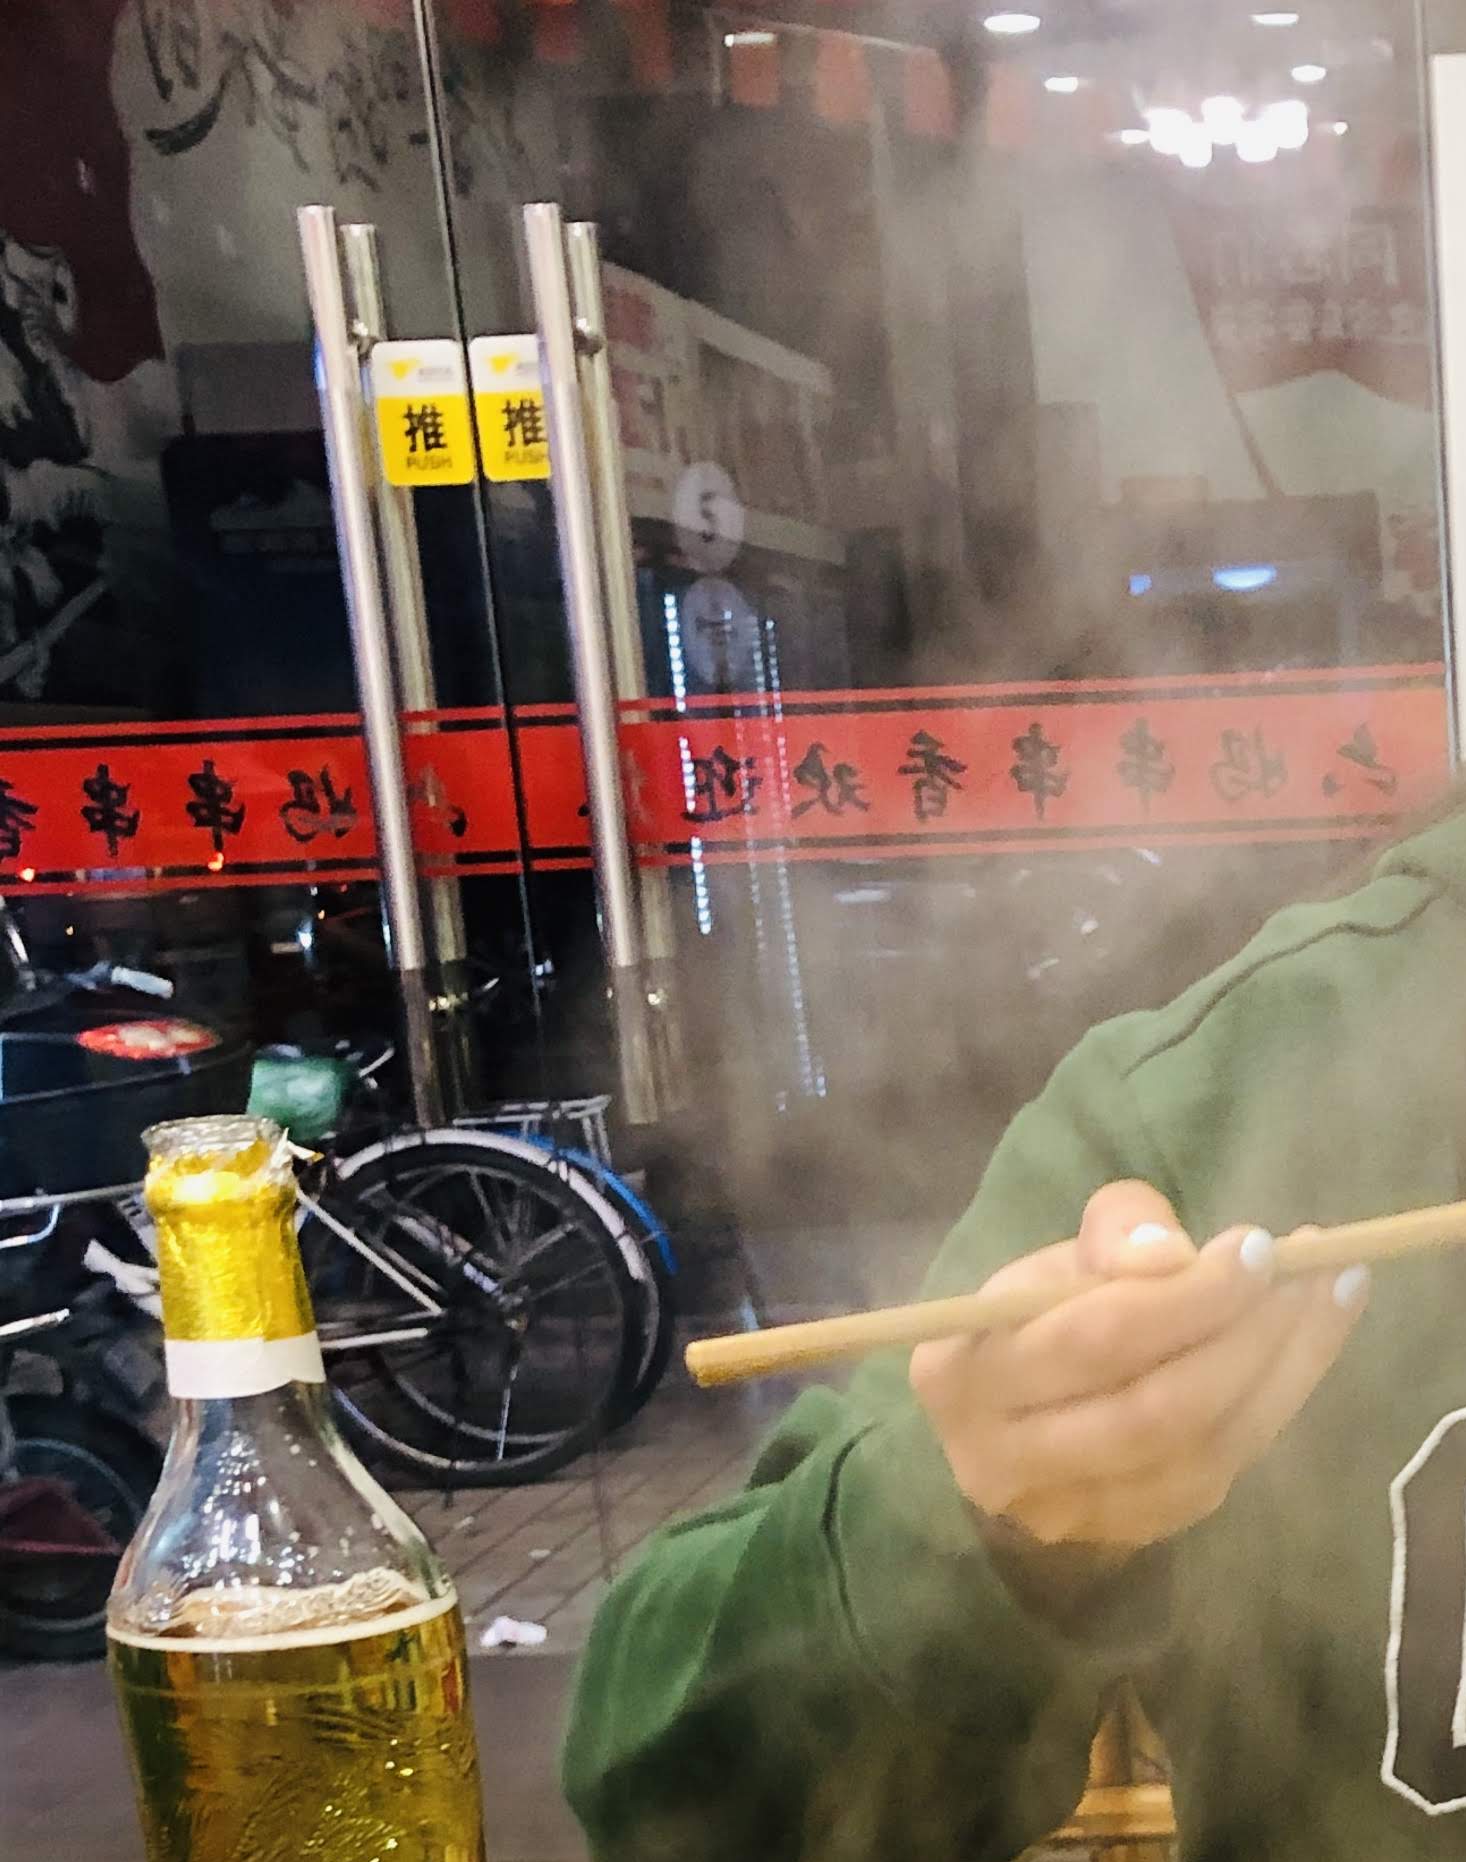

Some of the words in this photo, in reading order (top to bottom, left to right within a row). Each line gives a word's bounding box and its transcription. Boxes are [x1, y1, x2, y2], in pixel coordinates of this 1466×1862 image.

[403, 403, 447, 452] 推
[501, 397, 548, 448] 推
[405, 454, 453, 471] PUSH
